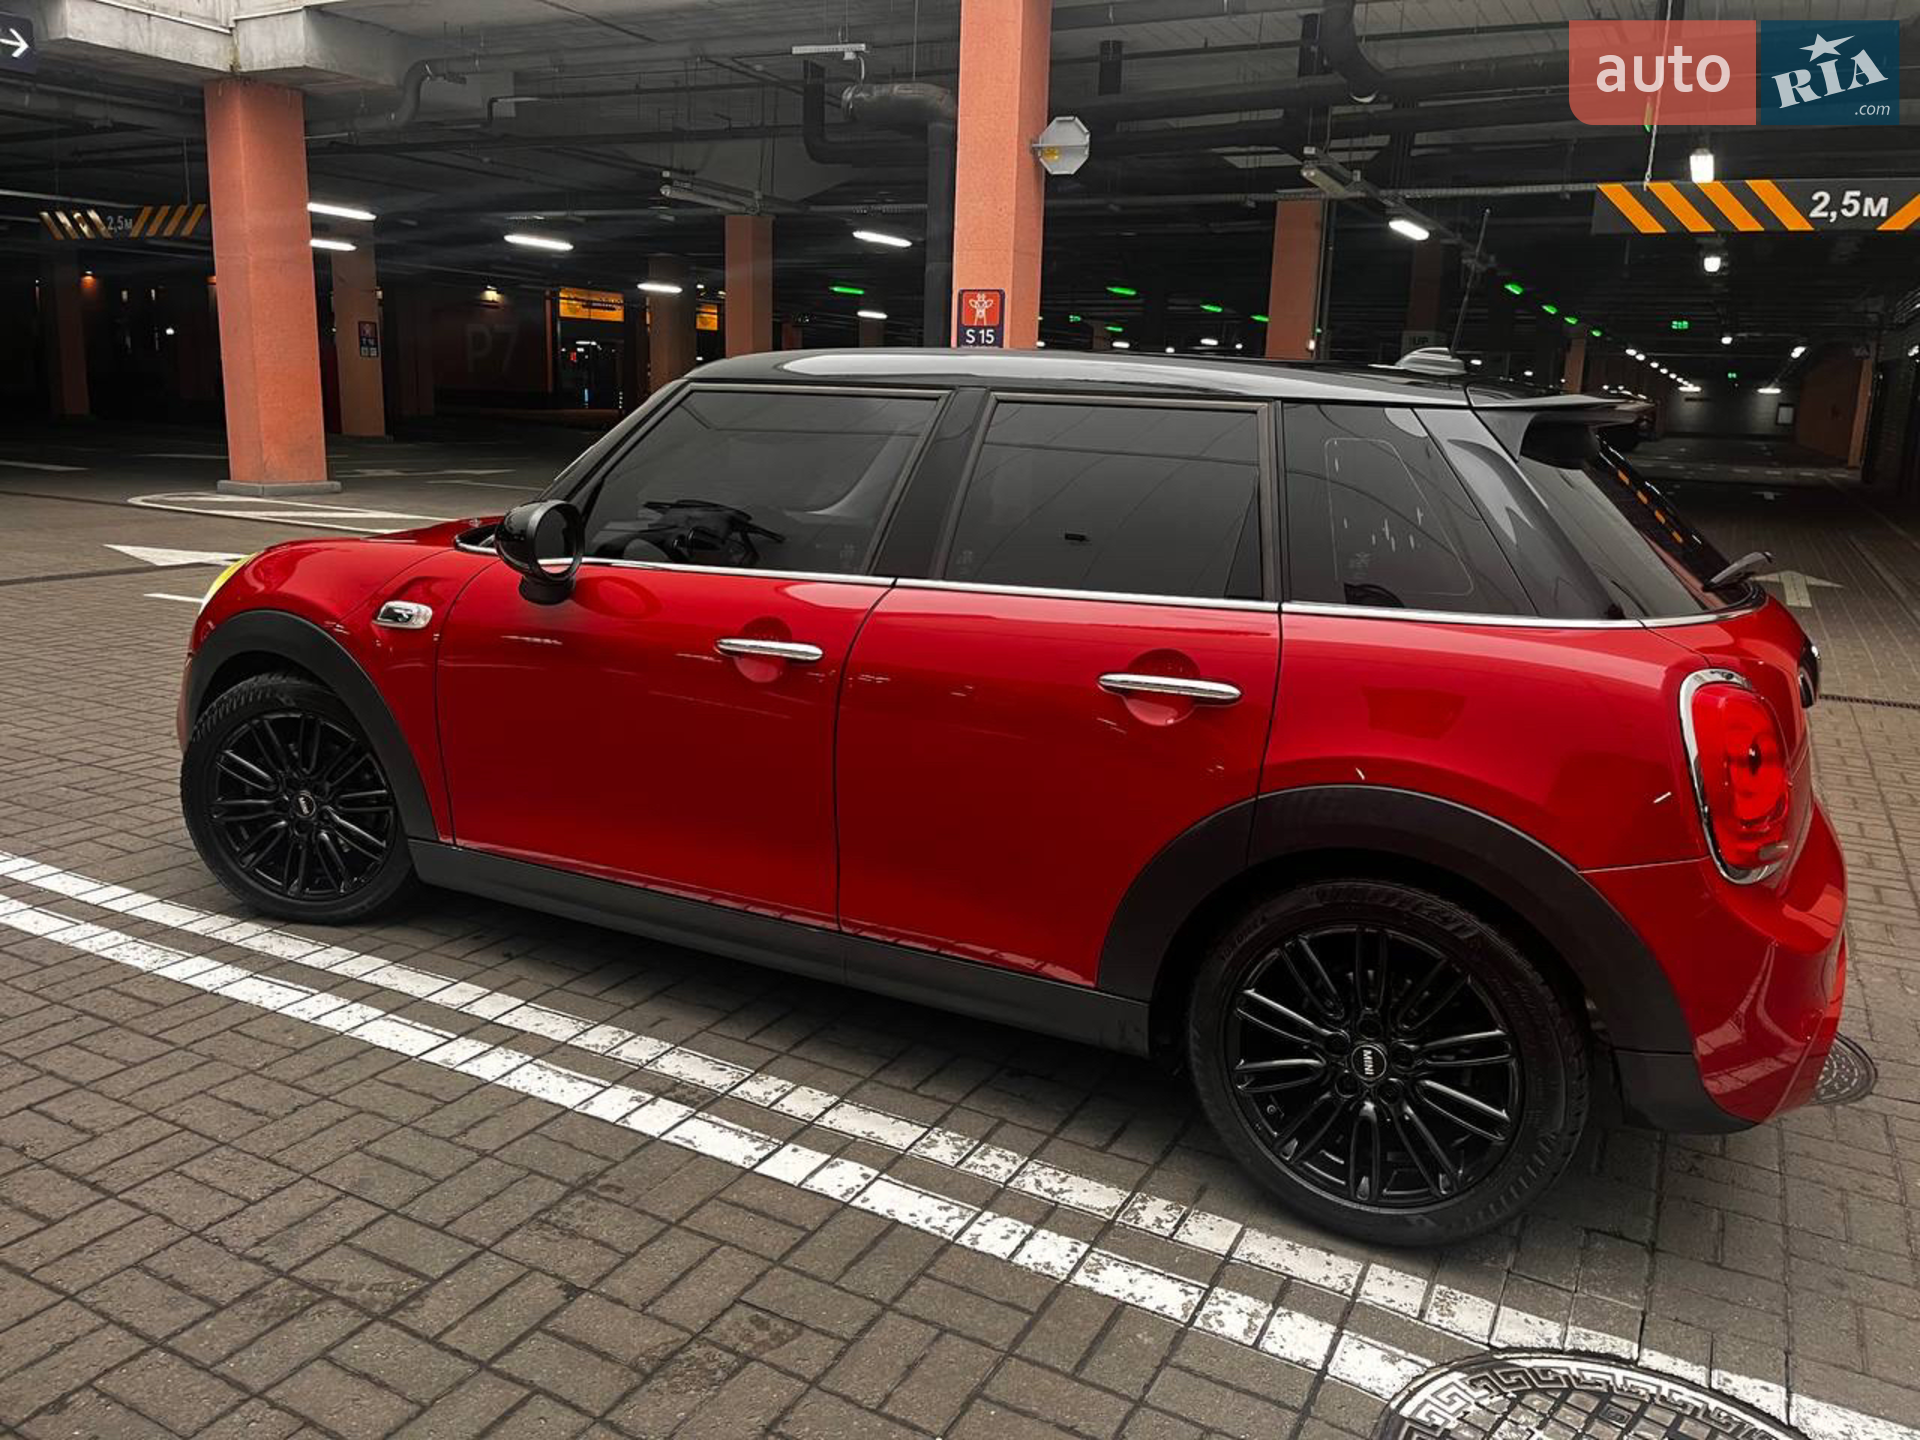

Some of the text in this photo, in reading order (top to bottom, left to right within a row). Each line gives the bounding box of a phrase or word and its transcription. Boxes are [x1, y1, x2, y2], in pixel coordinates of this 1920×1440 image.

[965, 328, 996, 344] S 15
[1363, 1049, 1375, 1075] MINI
